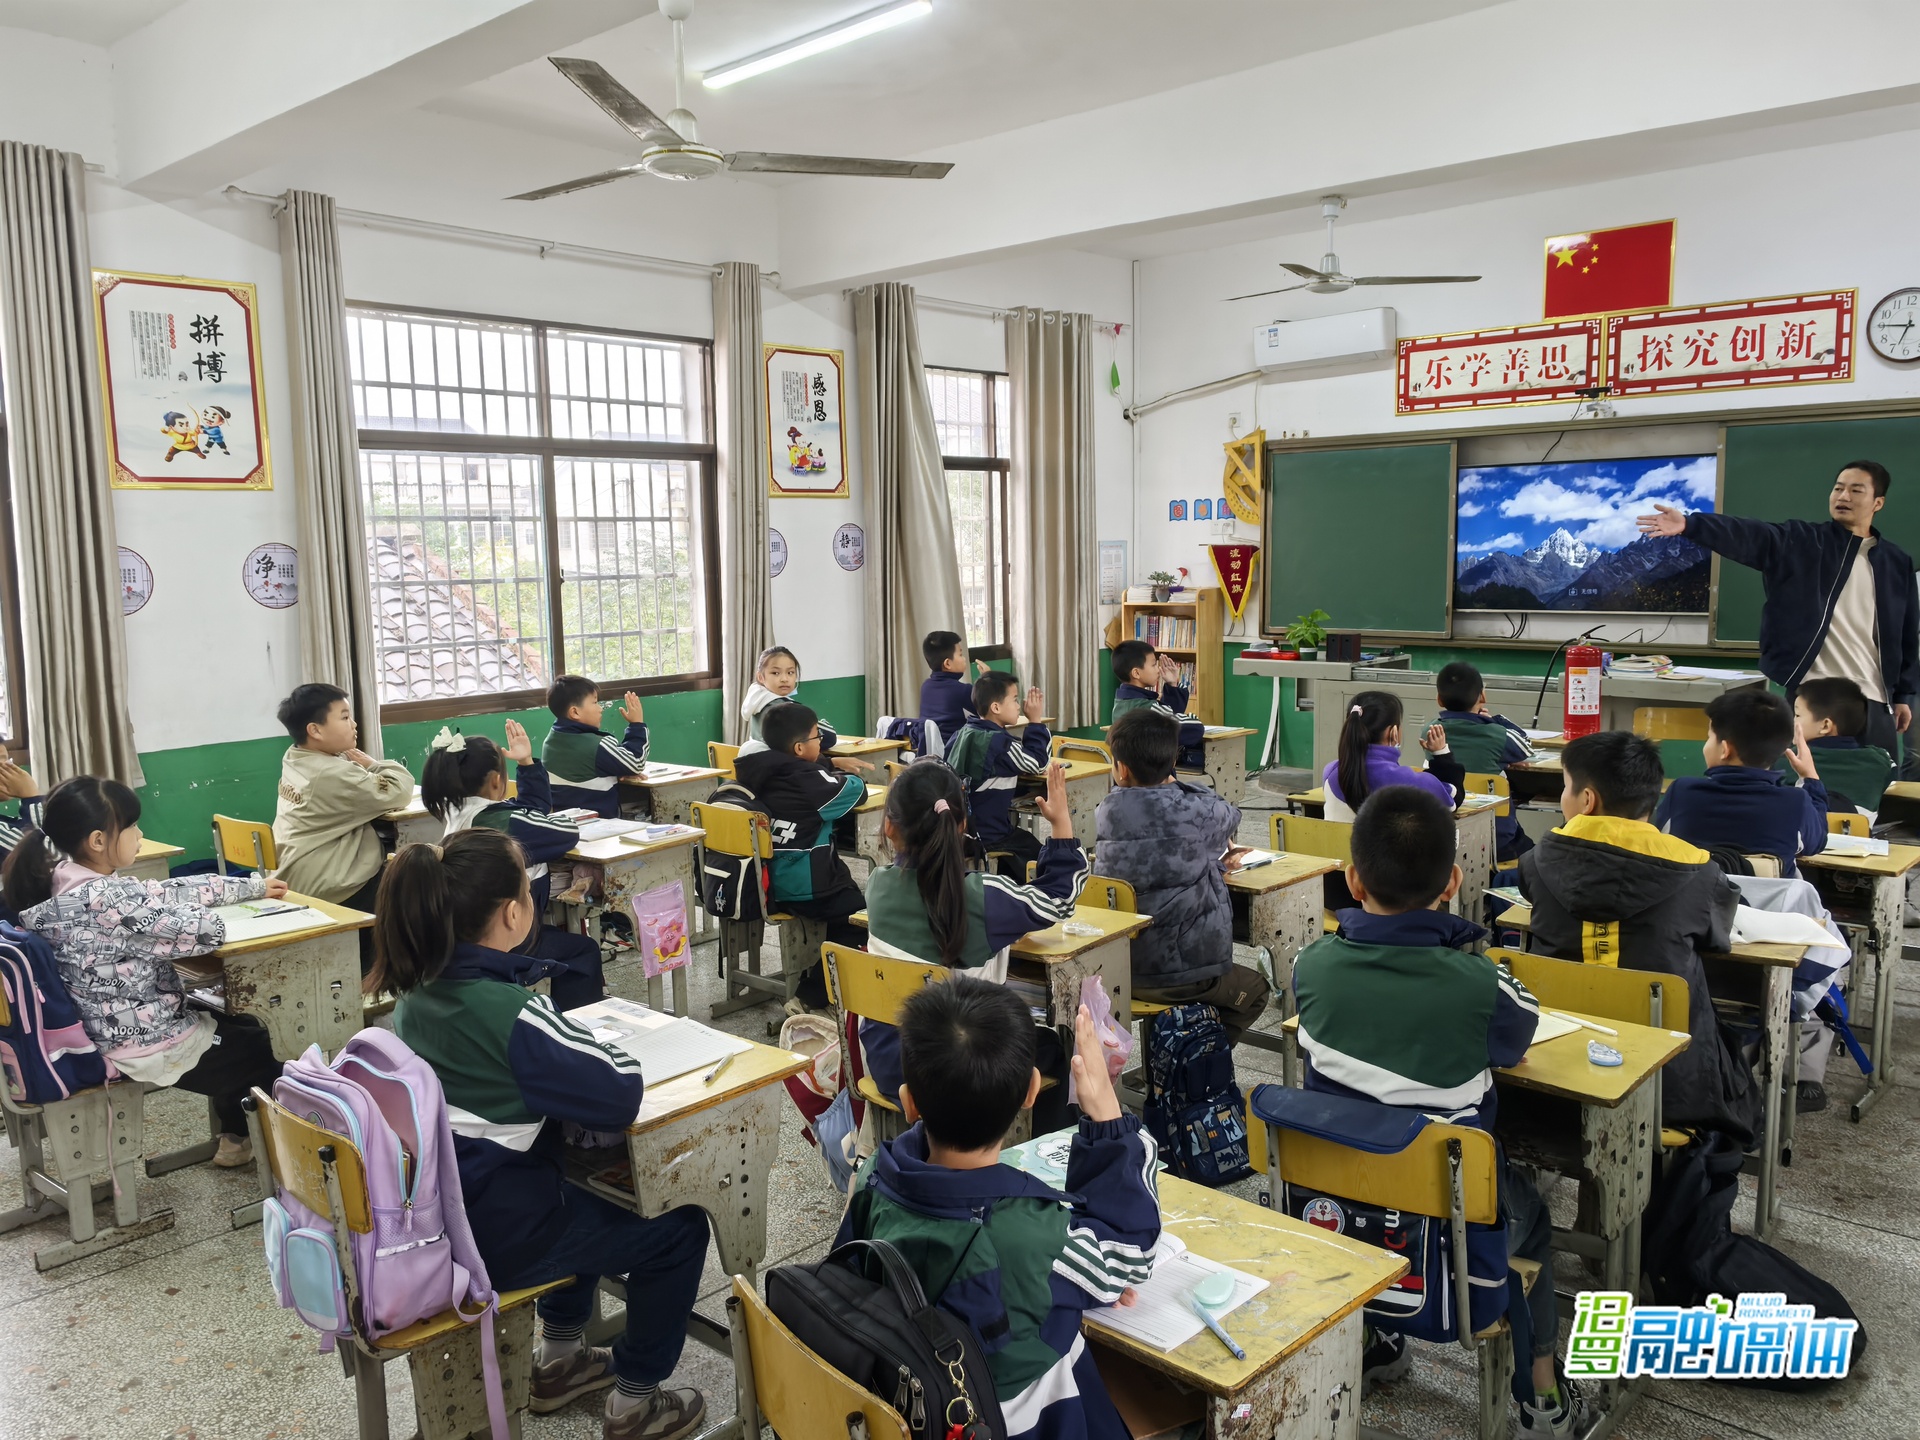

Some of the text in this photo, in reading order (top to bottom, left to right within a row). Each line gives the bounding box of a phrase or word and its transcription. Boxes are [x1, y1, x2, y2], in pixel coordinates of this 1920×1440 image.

[1893, 299, 1902, 310] 11
[1907, 295, 1918, 306] 12
[1881, 309, 1892, 320] 10
[1880, 333, 1888, 344] 8
[1636, 320, 1817, 373] 探究创新
[1889, 343, 1897, 354] 7
[1902, 346, 1910, 356] 6
[1424, 343, 1570, 390] 乐学善思
[811, 372, 828, 422] 感恩
[255, 553, 277, 579] 净
[1229, 548, 1243, 594] 流动红旗
